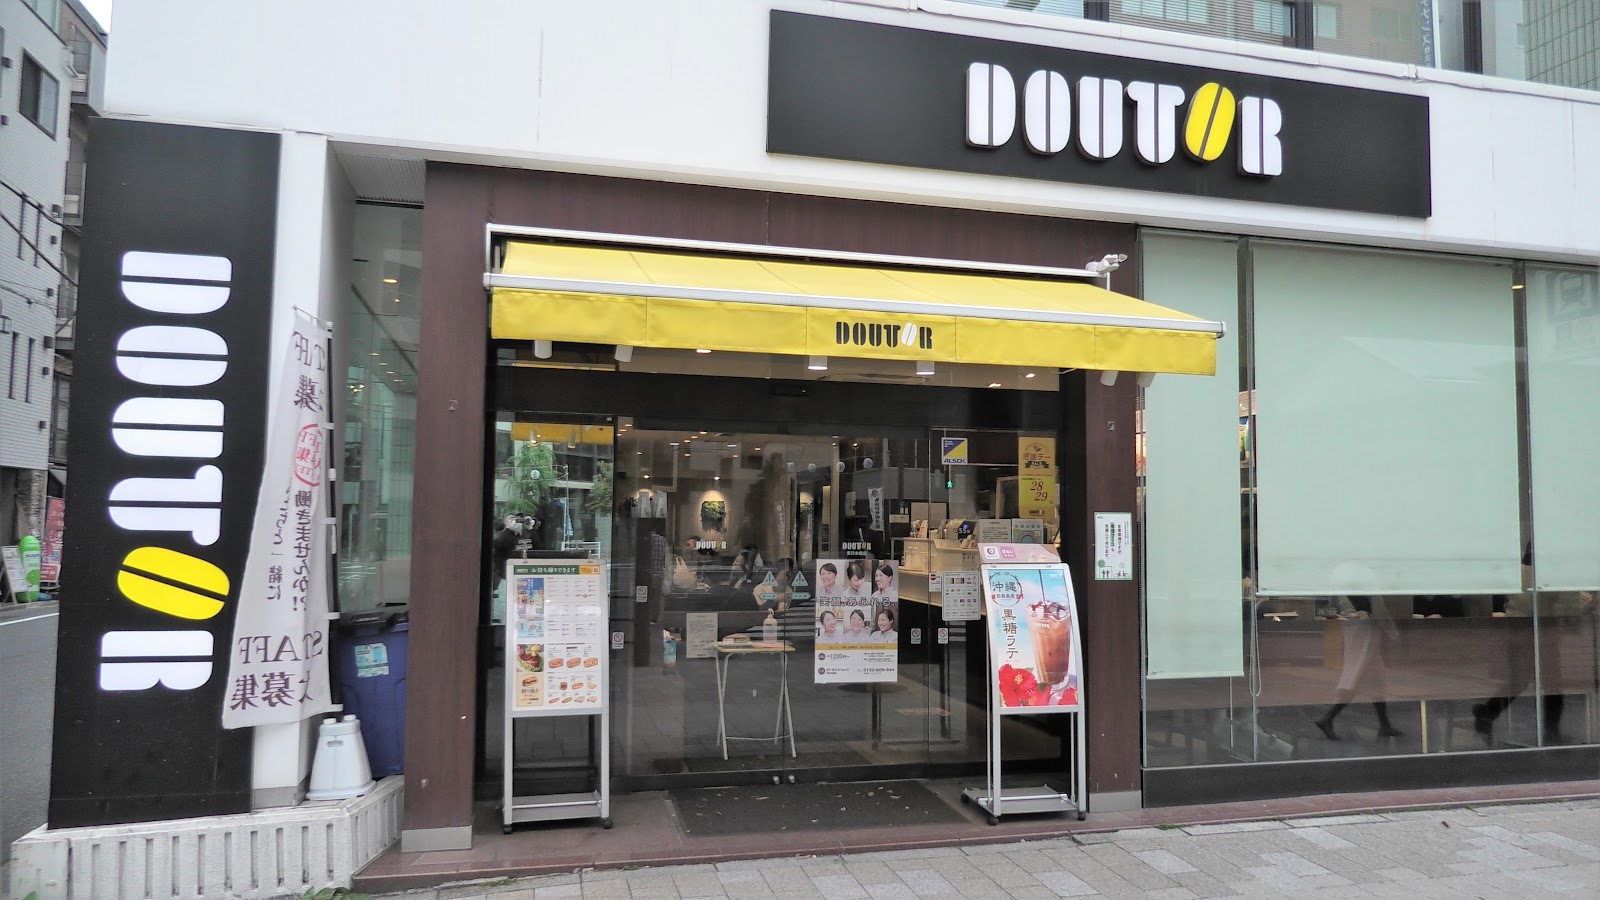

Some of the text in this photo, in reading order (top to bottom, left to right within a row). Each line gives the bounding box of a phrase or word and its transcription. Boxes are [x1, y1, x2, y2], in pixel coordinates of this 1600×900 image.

[966, 61, 1282, 177] DOUTOR
[836, 321, 933, 349] DOUTOR
[99, 250, 232, 691] DOUTOR
[1030, 481, 1044, 491] 28
[1034, 491, 1048, 502] 29
[992, 581, 1018, 592] 沖縄
[1002, 608, 1018, 659] 黒糖ラテ
